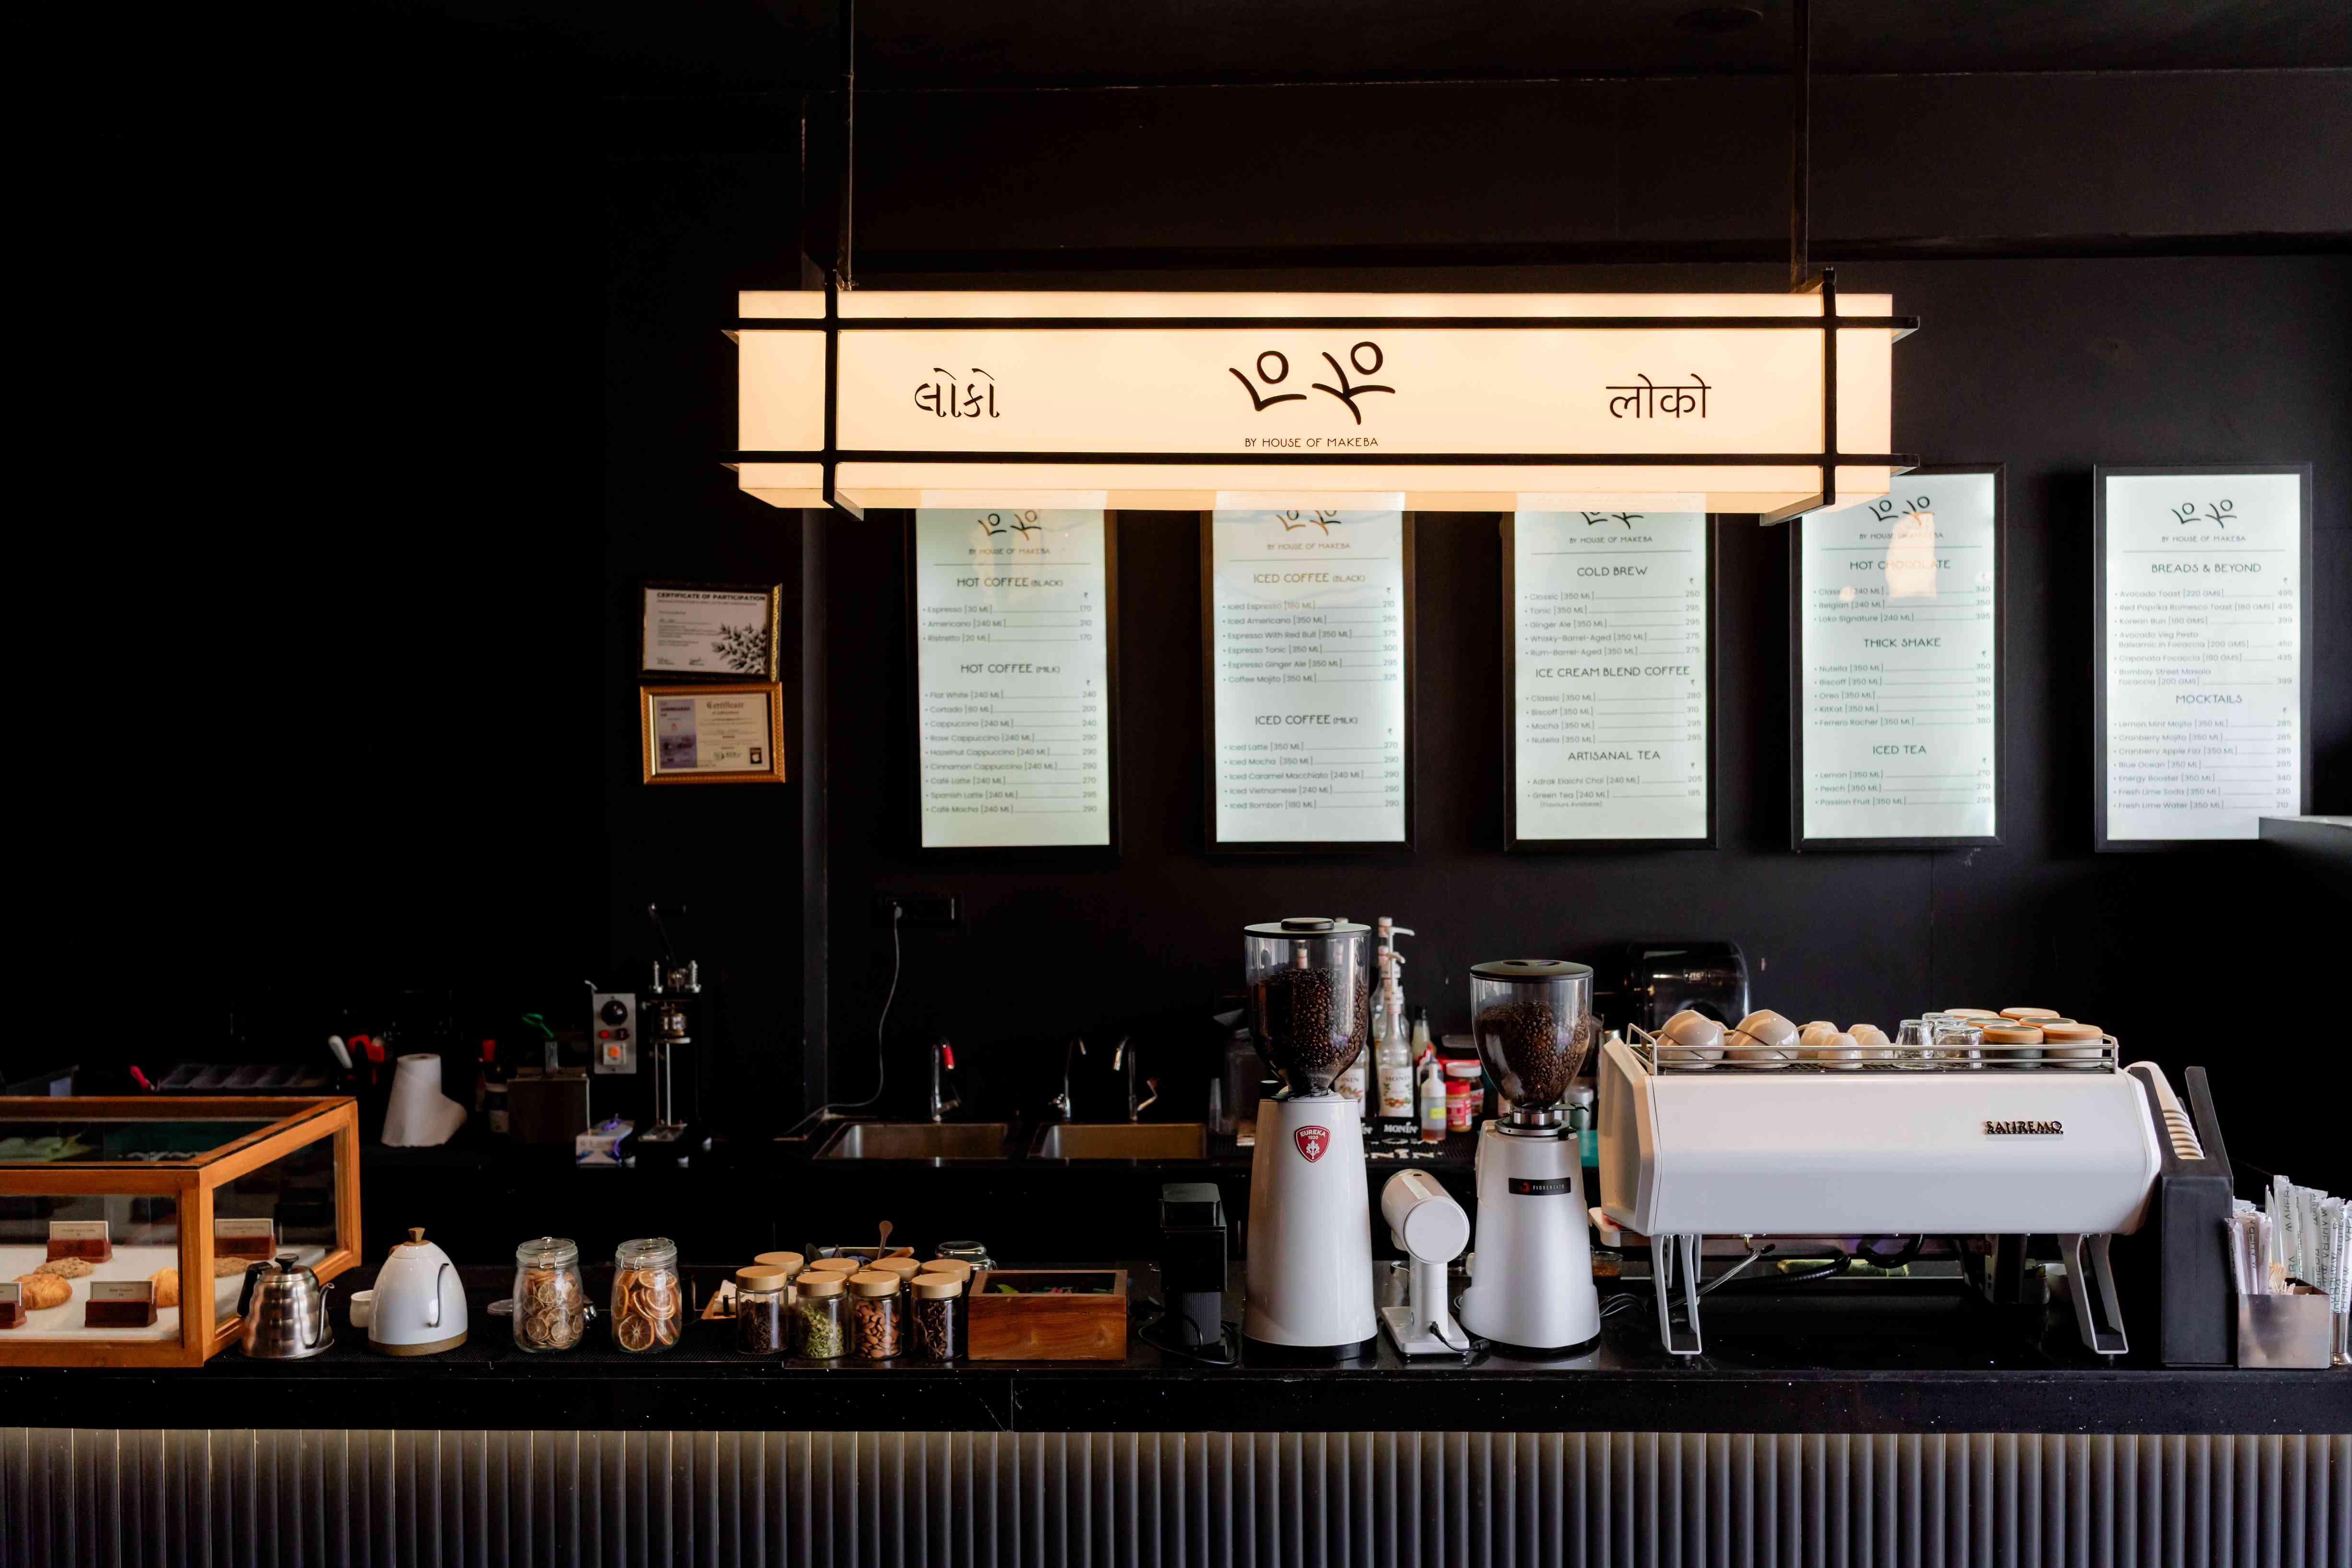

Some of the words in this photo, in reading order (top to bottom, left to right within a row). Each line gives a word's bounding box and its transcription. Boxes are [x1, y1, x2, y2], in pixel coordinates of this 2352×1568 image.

[914, 367, 1000, 419] લોકો
[1605, 373, 1711, 419] लोको
[1245, 438, 1257, 447] BY
[1262, 438, 1301, 447] HOUSE
[1307, 438, 1322, 447] OF
[1327, 437, 1379, 447] MAKEBA
[1850, 561, 1873, 570] HOT
[2152, 564, 2198, 573] BREADS
[2203, 564, 2210, 573] &
[2215, 564, 2261, 573] BEYOND
[1577, 567, 1609, 577] COLD
[1614, 567, 1648, 576] BREW
[957, 578, 979, 587] HOT
[984, 578, 1029, 587] COFFEE
[1254, 574, 1279, 584] ICED
[1284, 573, 1329, 583] COFFEE
[1333, 575, 1365, 583] (BLACK)
[1864, 638, 1897, 648] THICK
[1902, 638, 1941, 647] SHAKE
[960, 664, 983, 673] HOT
[988, 664, 1032, 673] COFFEE
[1536, 669, 1553, 678] ICE
[1557, 668, 1600, 678] CREAM
[1603, 667, 1640, 677] BLEND
[1645, 667, 1690, 676] COFFEE
[2176, 694, 2242, 704] MOCKTAILS
[1255, 715, 1281, 725] ICED
[1286, 715, 1330, 725] COFFEE
[1872, 746, 1899, 755] ICED
[1903, 745, 1926, 754] TEA
[1568, 752, 1633, 761] ARTISANAL
[1638, 750, 1661, 760] TEA
[1986, 1121, 2063, 1134] SANREMO
